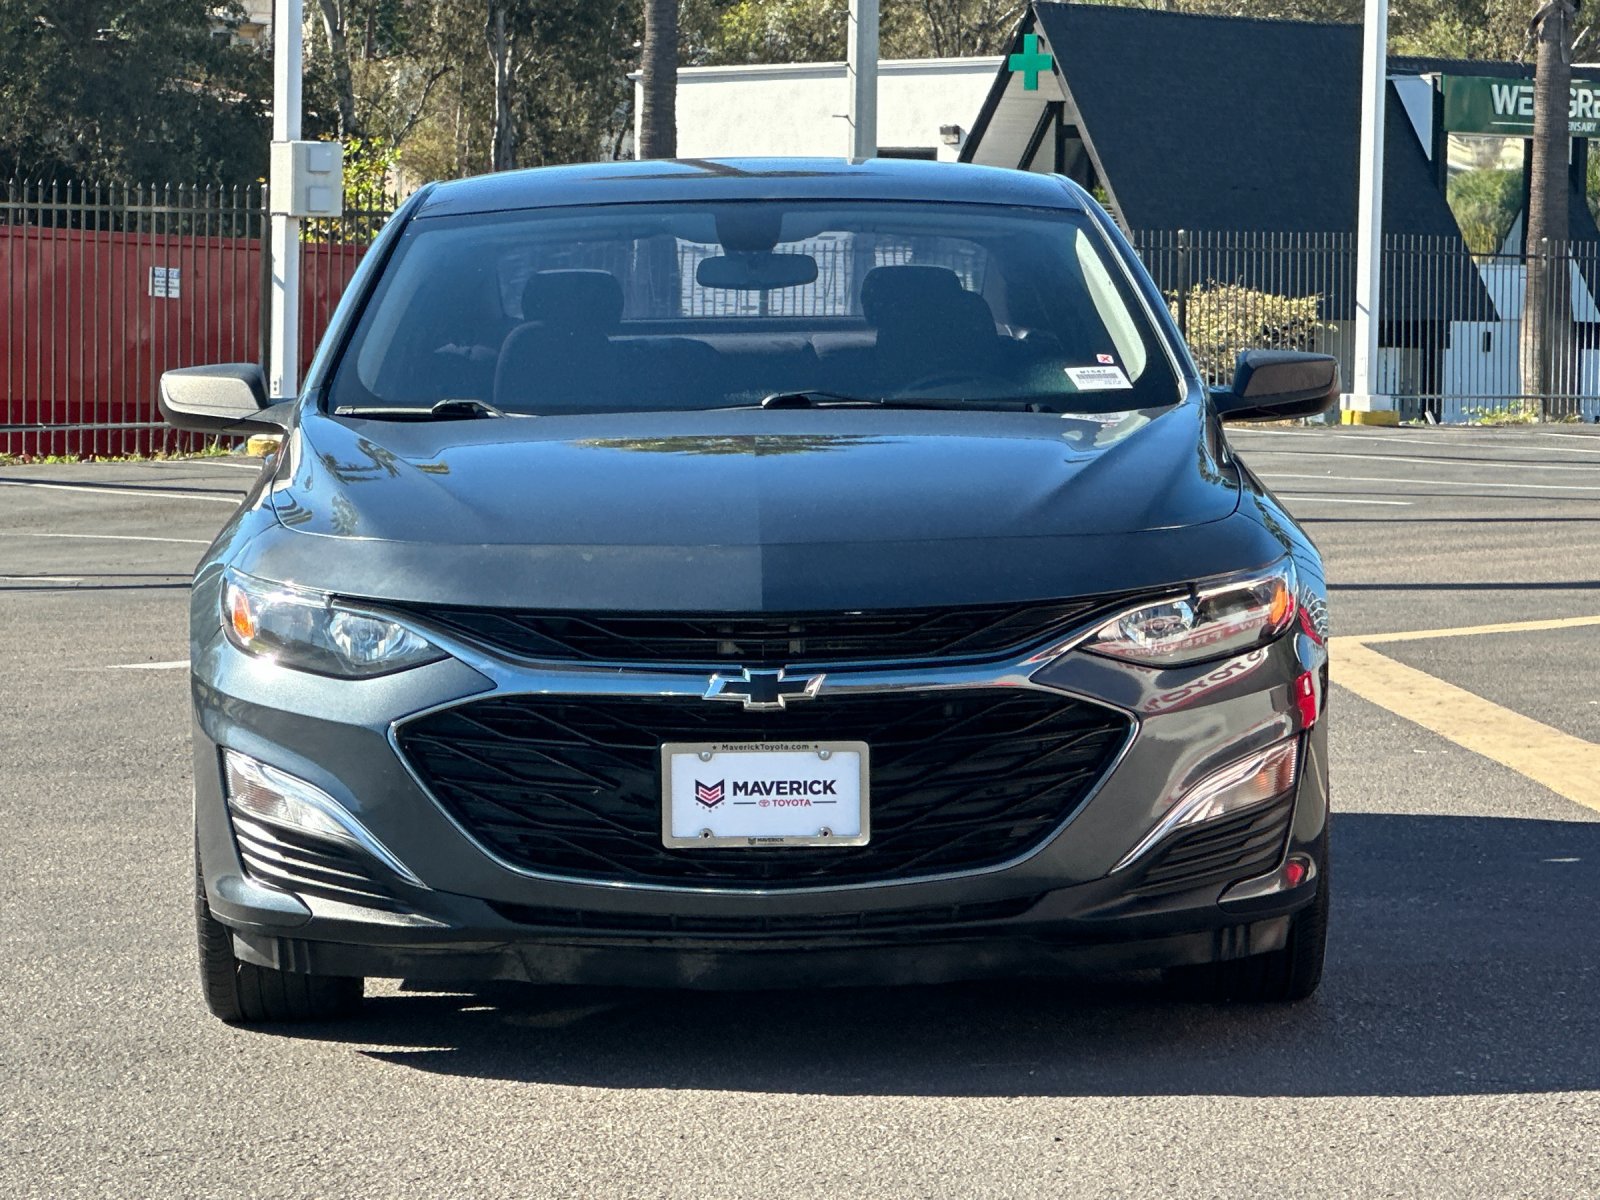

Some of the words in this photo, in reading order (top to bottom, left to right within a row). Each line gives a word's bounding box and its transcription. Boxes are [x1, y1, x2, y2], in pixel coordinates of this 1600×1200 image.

[1568, 121, 1597, 132] ENSARY
[722, 743, 810, 751] MaverickToyota.com
[732, 779, 837, 797] MAVERICK
[772, 799, 812, 807] TOYOTA
